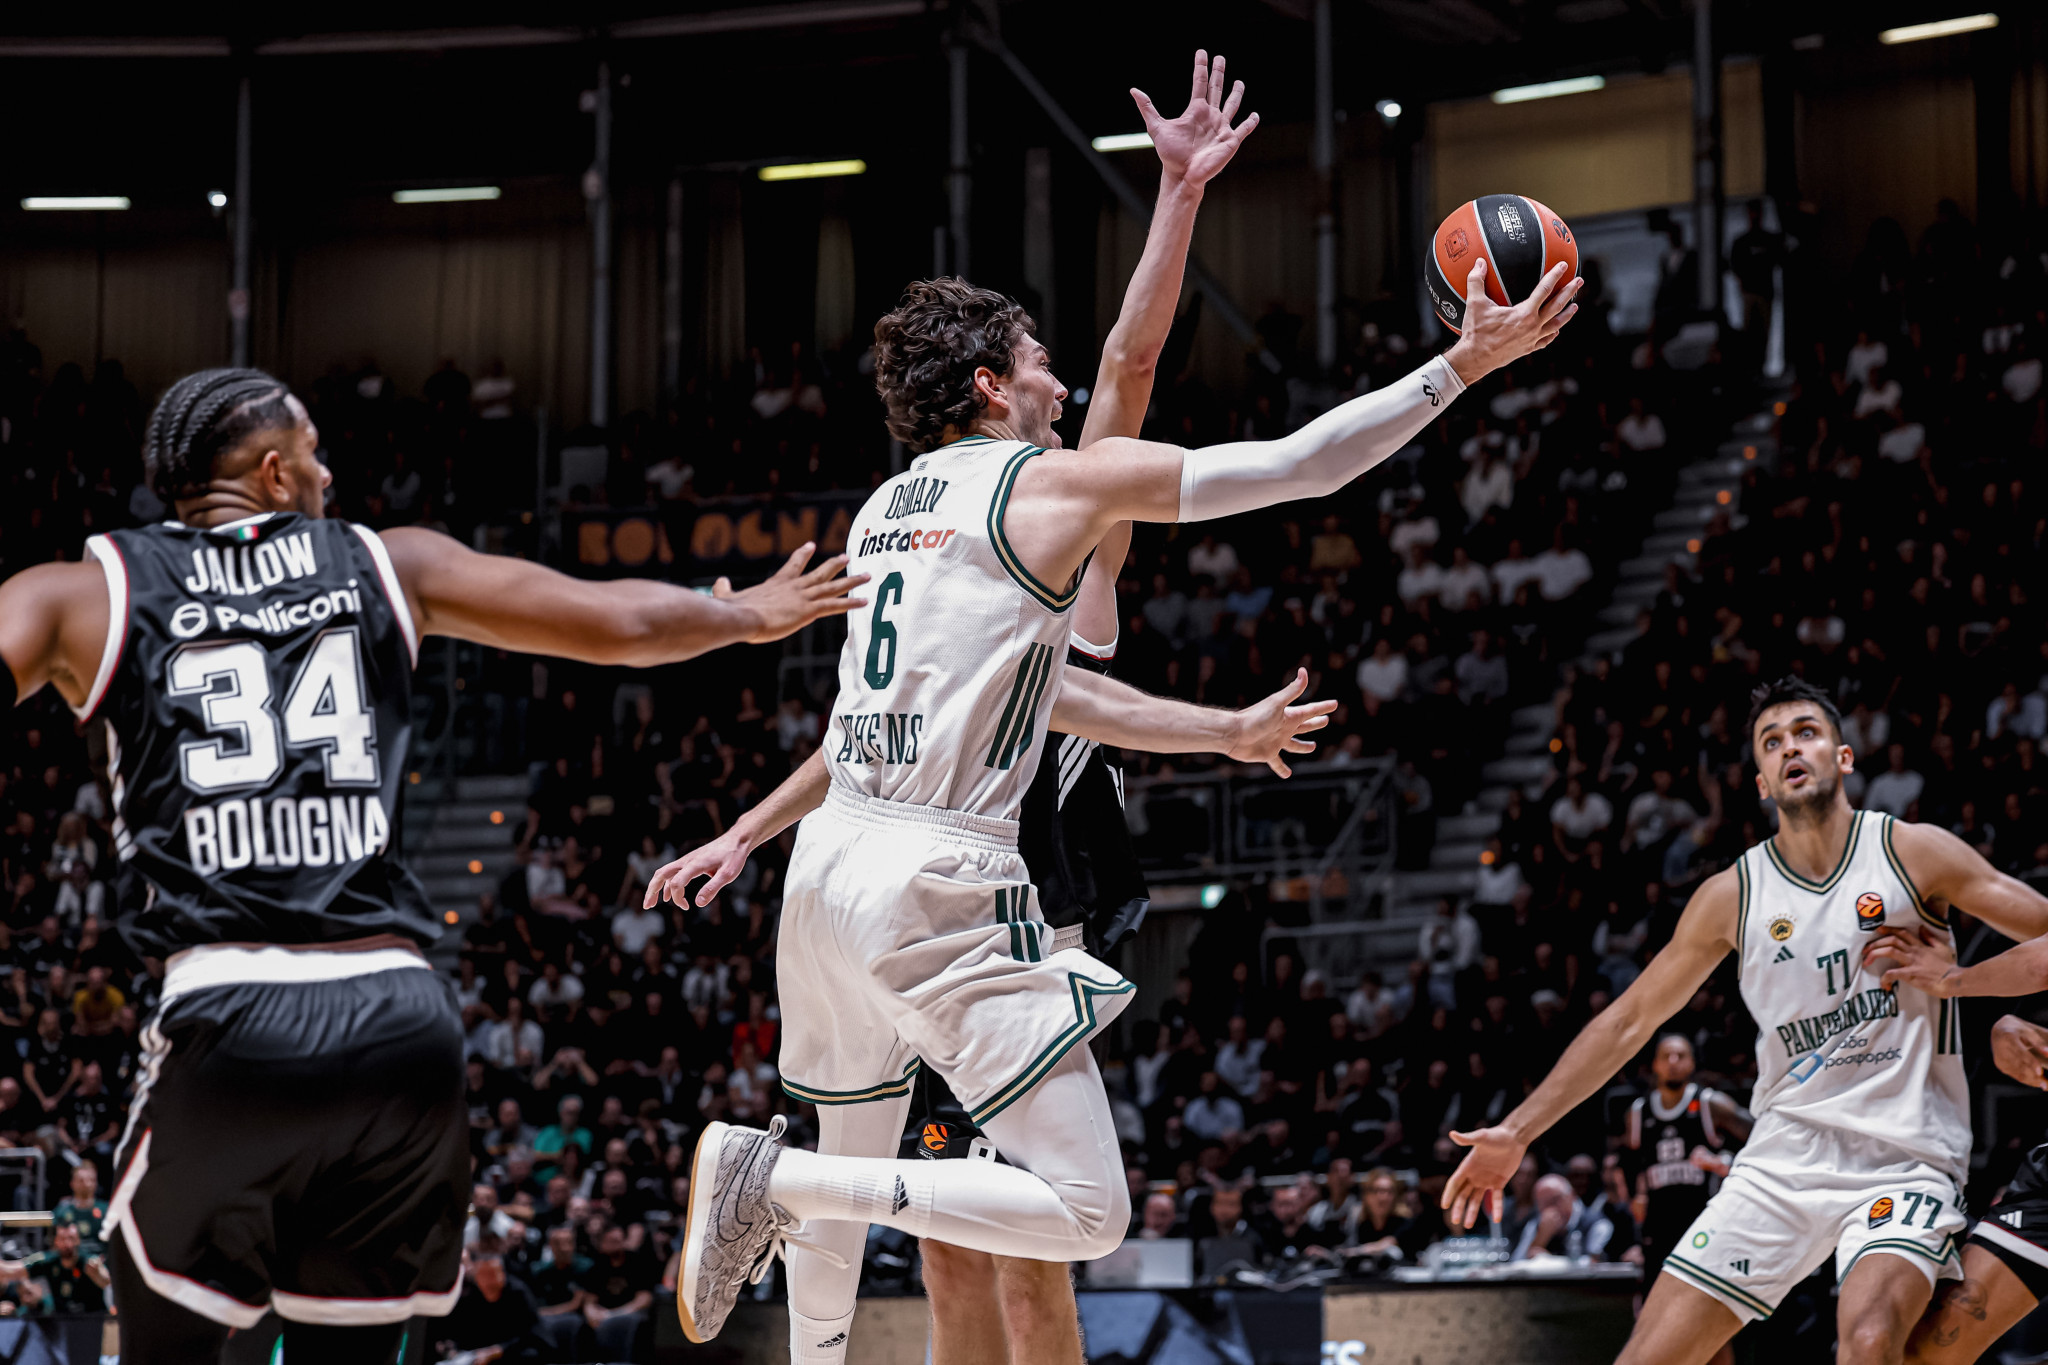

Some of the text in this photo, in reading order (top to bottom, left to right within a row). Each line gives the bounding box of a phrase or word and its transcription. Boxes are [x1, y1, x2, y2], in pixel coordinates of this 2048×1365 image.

[185, 532, 317, 595] JALLOW
[858, 528, 956, 557] instacar
[864, 571, 904, 690] 6
[166, 625, 382, 796] 34
[184, 795, 390, 876] BOLOGNA
[1817, 949, 1851, 996] 77
[1901, 1192, 1944, 1229] 77
